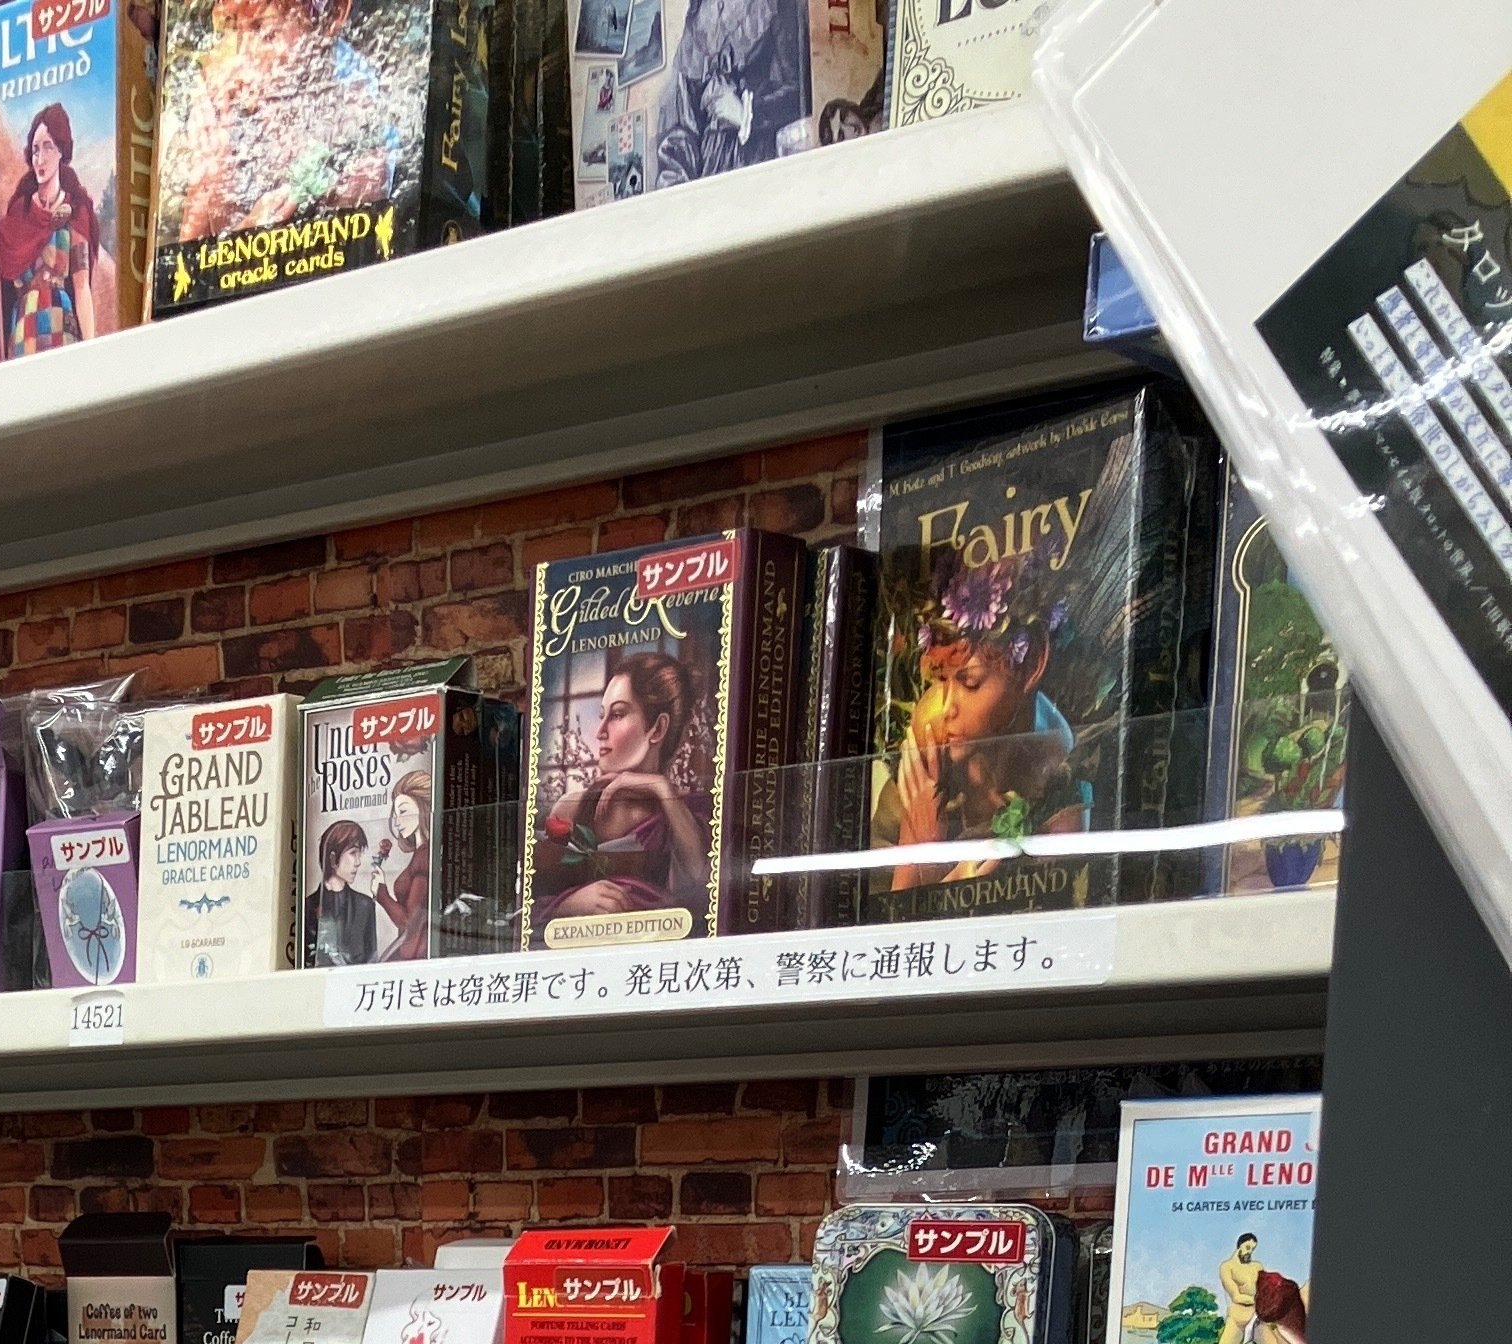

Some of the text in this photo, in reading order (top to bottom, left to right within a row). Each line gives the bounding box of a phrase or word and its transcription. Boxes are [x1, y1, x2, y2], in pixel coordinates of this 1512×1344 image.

[128, 85, 155, 284] CELTIC
[199, 212, 371, 270] LENORMAND
[220, 245, 345, 290] oracle cards
[918, 484, 1093, 572] Fairy
[643, 556, 729, 591] サンプル
[548, 584, 620, 657] Gilded
[571, 627, 662, 654] LENORMAND
[198, 717, 267, 740] サンプル
[360, 707, 436, 738] サンプル
[160, 750, 263, 799] GRAND
[322, 755, 390, 812] Roses
[338, 789, 388, 811] Lenormand
[150, 792, 268, 841] TABLEAU
[59, 836, 125, 865] サンプル
[156, 835, 258, 865] LENORMAND
[354, 934, 1056, 1013] 万引きは窃盗罪です。発見次第、警察に通報します。
[71, 1003, 124, 1032] 14521
[1204, 1129, 1292, 1155] GRAND
[1146, 1167, 1174, 1188] DE
[1172, 1199, 1309, 1212] 54 CARTES AVEC LIVRET
[914, 1227, 1012, 1256] サンプル
[295, 1280, 360, 1304] サンプル
[433, 1283, 487, 1302] サンプル
[563, 1277, 641, 1301] サンプル
